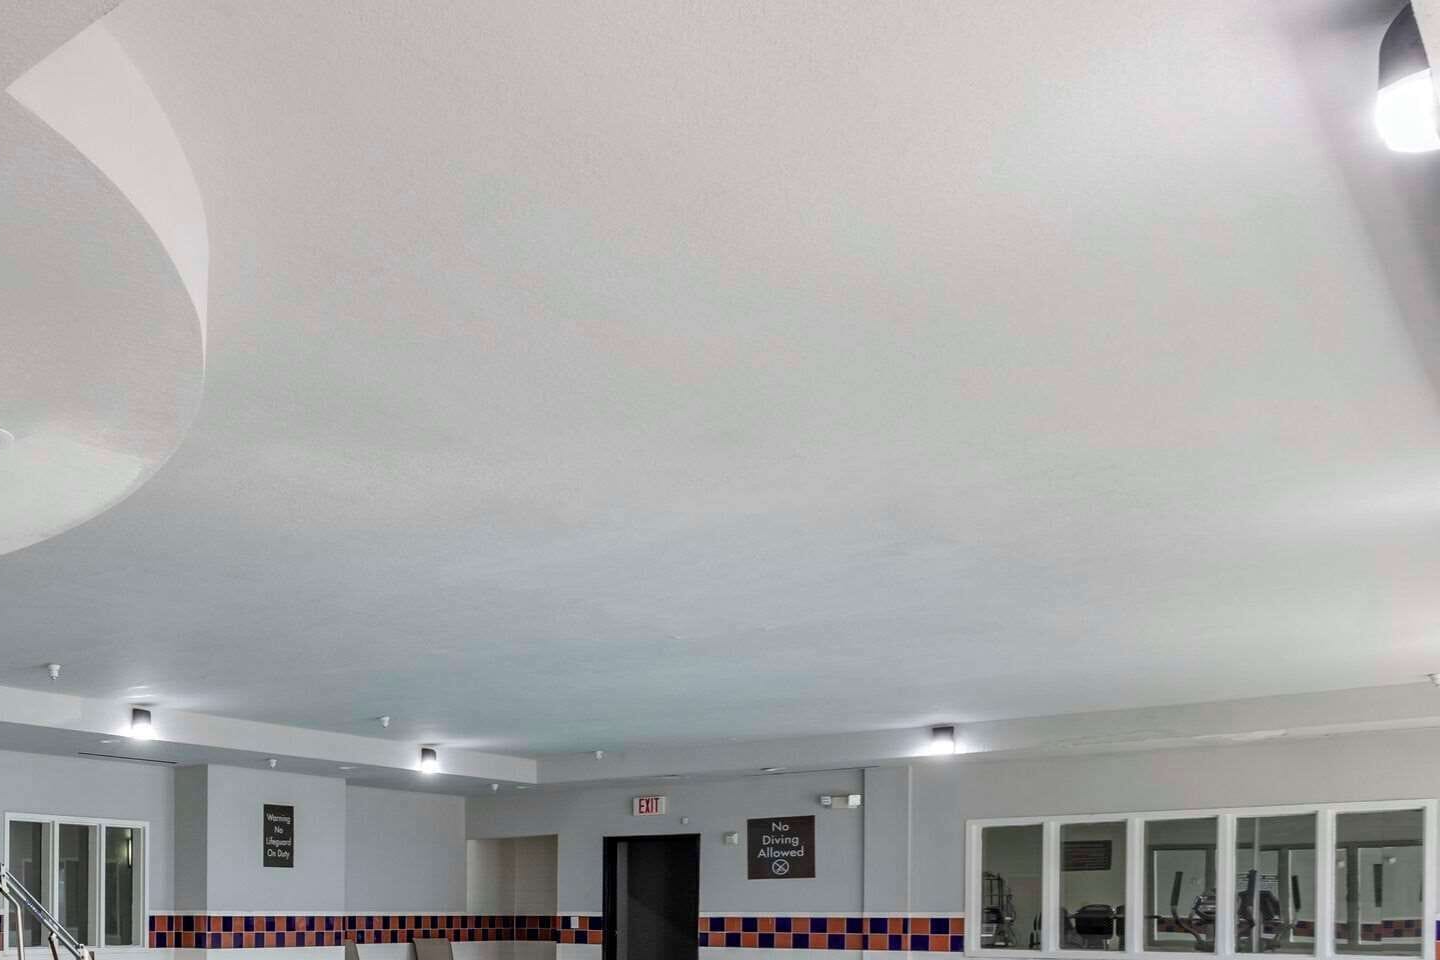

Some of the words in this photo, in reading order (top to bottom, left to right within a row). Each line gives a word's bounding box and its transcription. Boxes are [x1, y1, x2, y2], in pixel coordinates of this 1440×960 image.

[639, 797, 659, 814] EXIT
[266, 813, 291, 825] Warning
[274, 825, 284, 834] No
[771, 821, 789, 831] No
[265, 836, 291, 848] Lifeguard
[762, 834, 799, 847] Diving
[267, 848, 277, 857] On
[278, 848, 290, 860] Duty
[757, 845, 804, 858] Allowed
